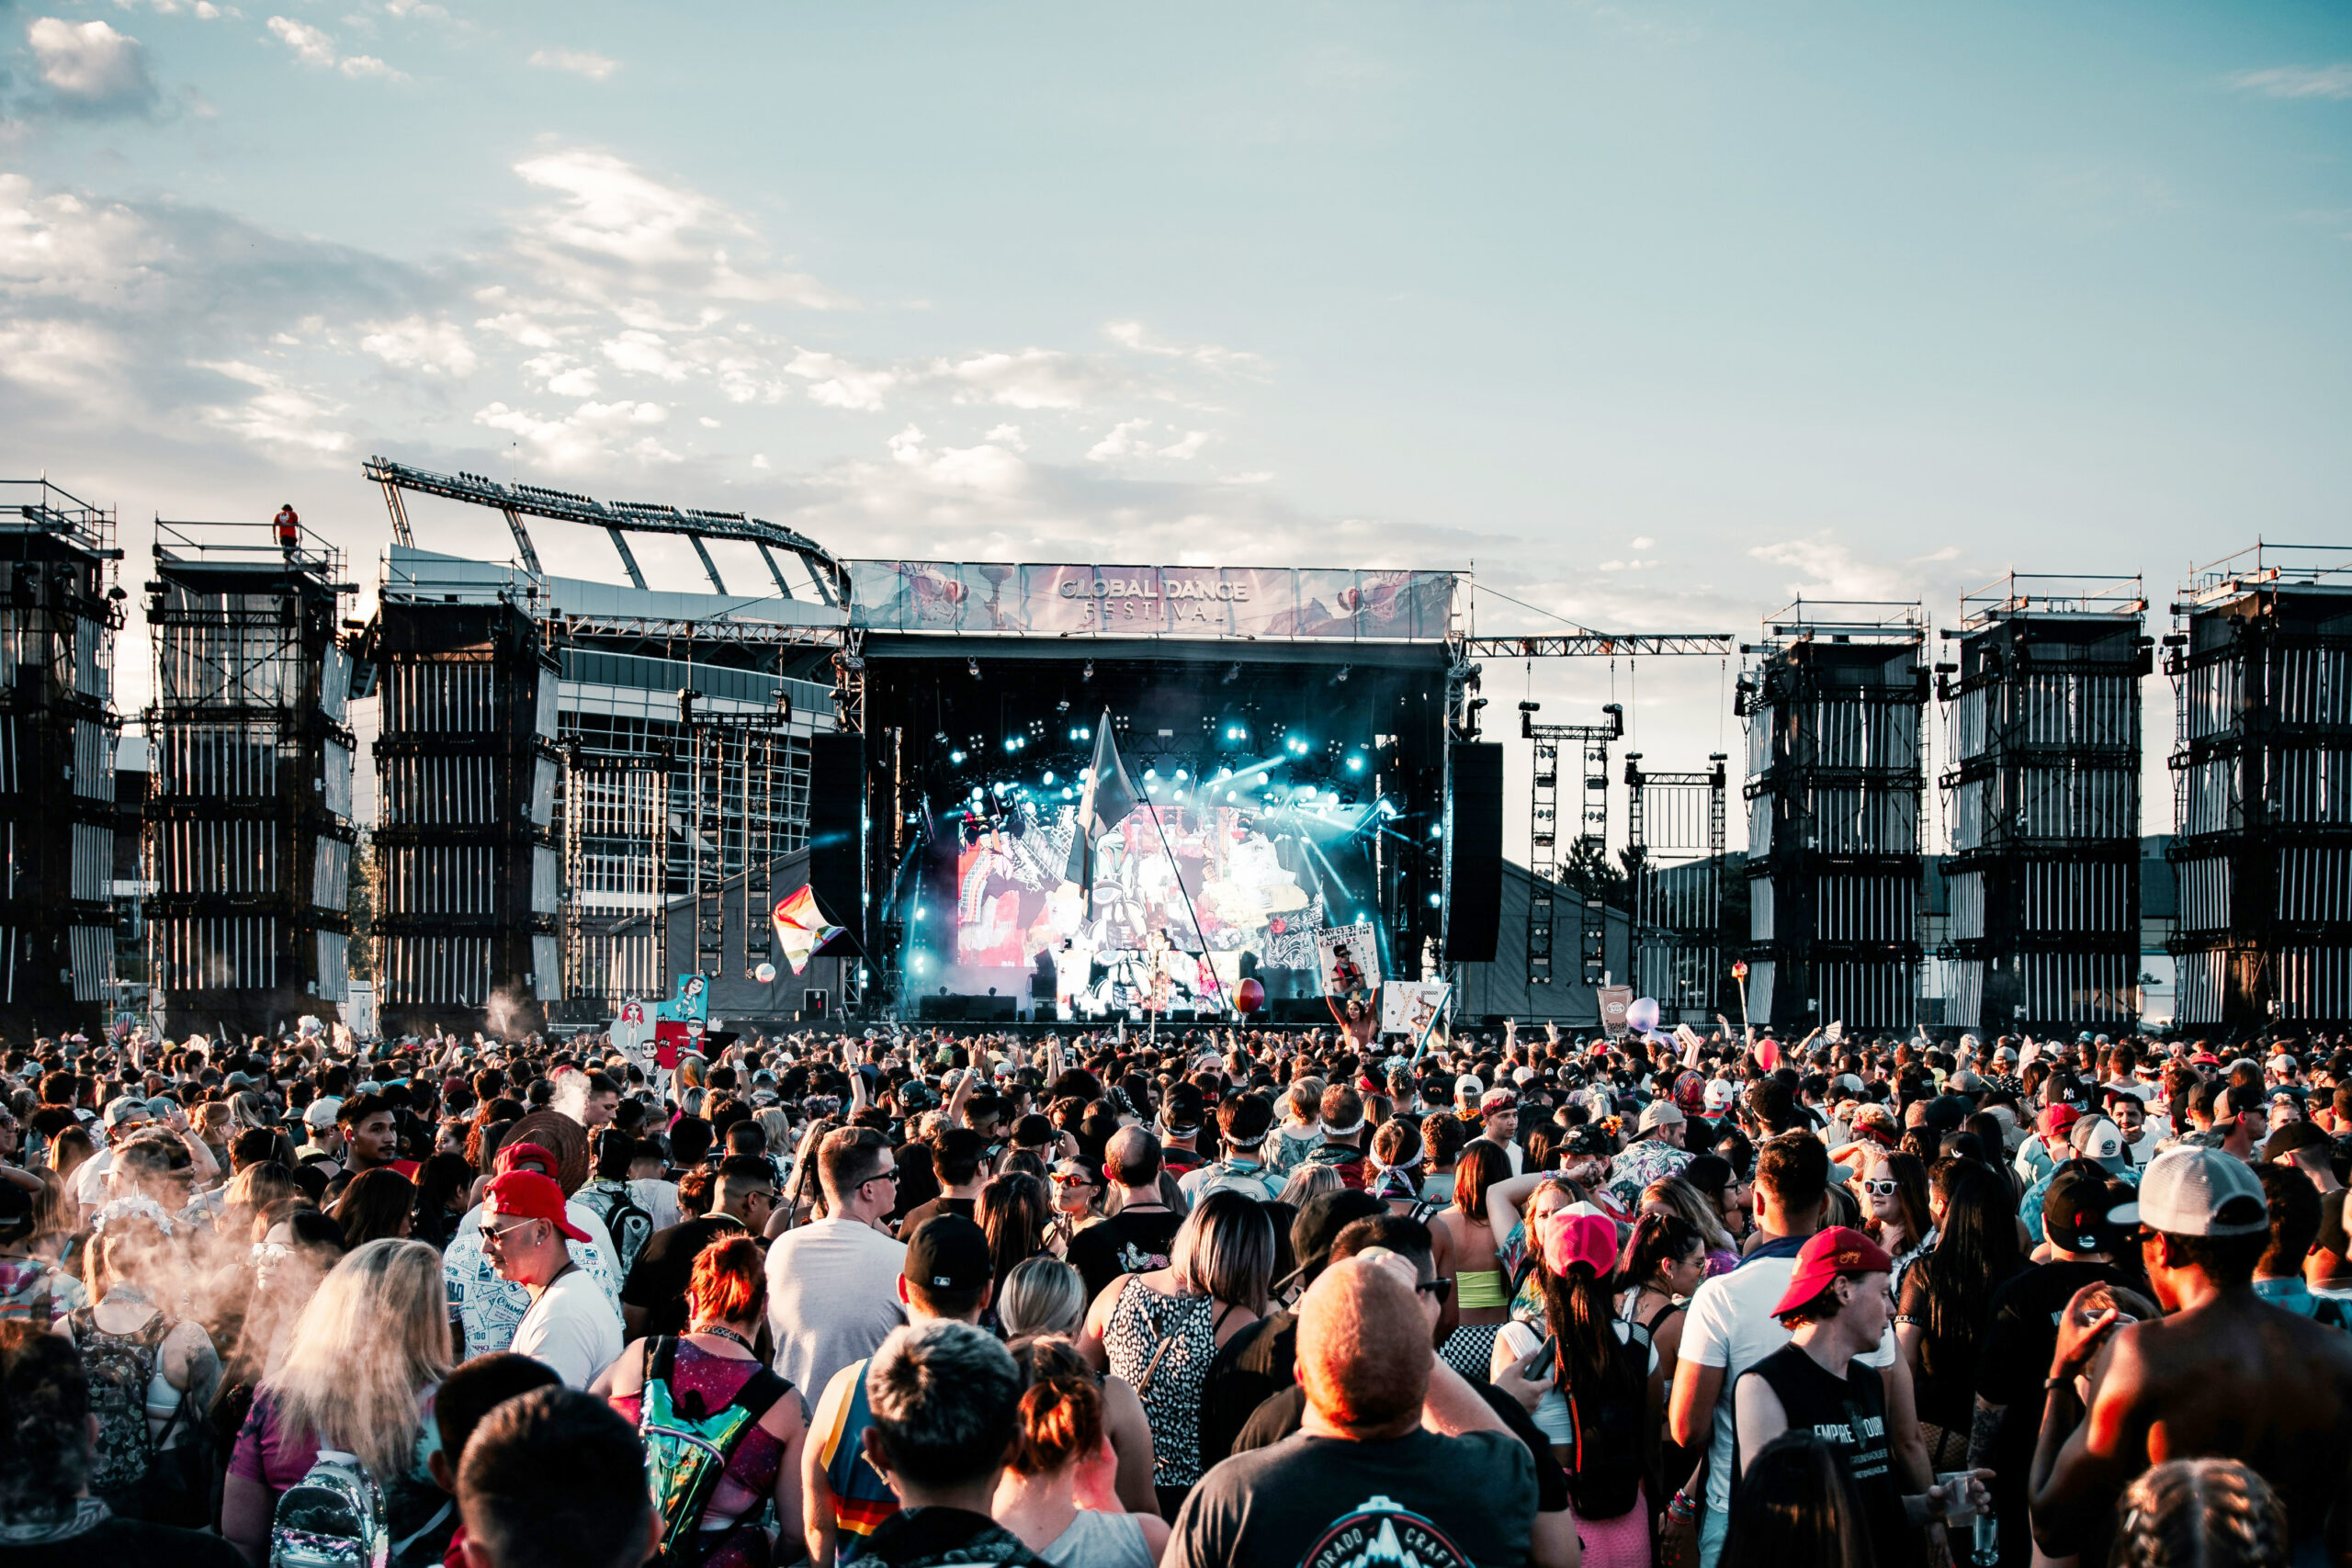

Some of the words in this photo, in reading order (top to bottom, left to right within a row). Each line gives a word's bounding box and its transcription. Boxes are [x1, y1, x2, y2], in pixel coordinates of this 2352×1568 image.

[1059, 579, 1159, 600] GLOBAL
[1164, 579, 1250, 603] DANCE
[1318, 929, 1335, 937] DAY
[1319, 937, 1358, 949] KASKADE
[474, 1332, 486, 1340] 100
[1404, 1528, 1458, 1568] CRAFT
